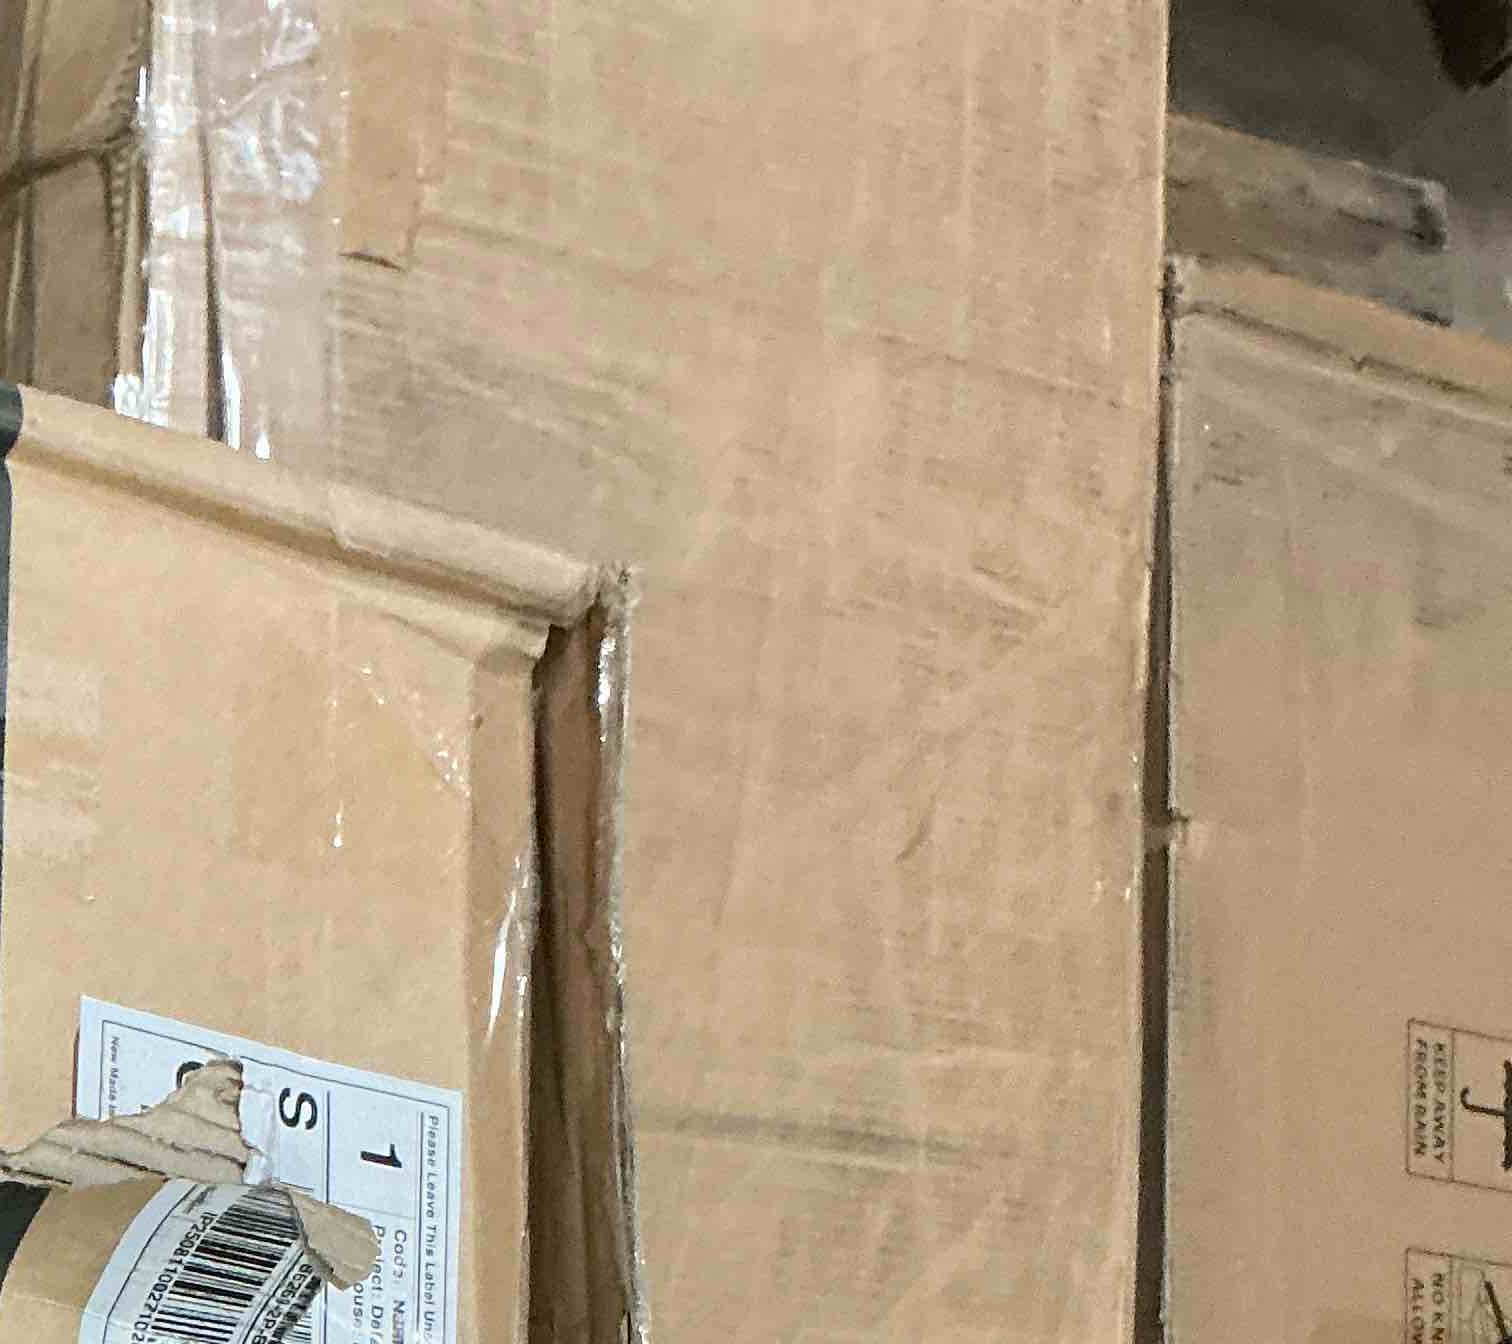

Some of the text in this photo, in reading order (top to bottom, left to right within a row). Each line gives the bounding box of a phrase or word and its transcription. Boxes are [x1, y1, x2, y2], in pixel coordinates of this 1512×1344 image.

[109, 1036, 121, 1063] New
[108, 1067, 120, 1099] Made
[1414, 1040, 1428, 1156] FROM RAIN
[1432, 1042, 1446, 1164] KEEP AWAY
[278, 1087, 318, 1131] S
[359, 1143, 402, 1170] 1
[426, 1115, 439, 1166] Please
[425, 1172, 438, 1218] Leave
[424, 1224, 437, 1256] This
[423, 1262, 436, 1305] Label
[1432, 1273, 1445, 1305] NO
